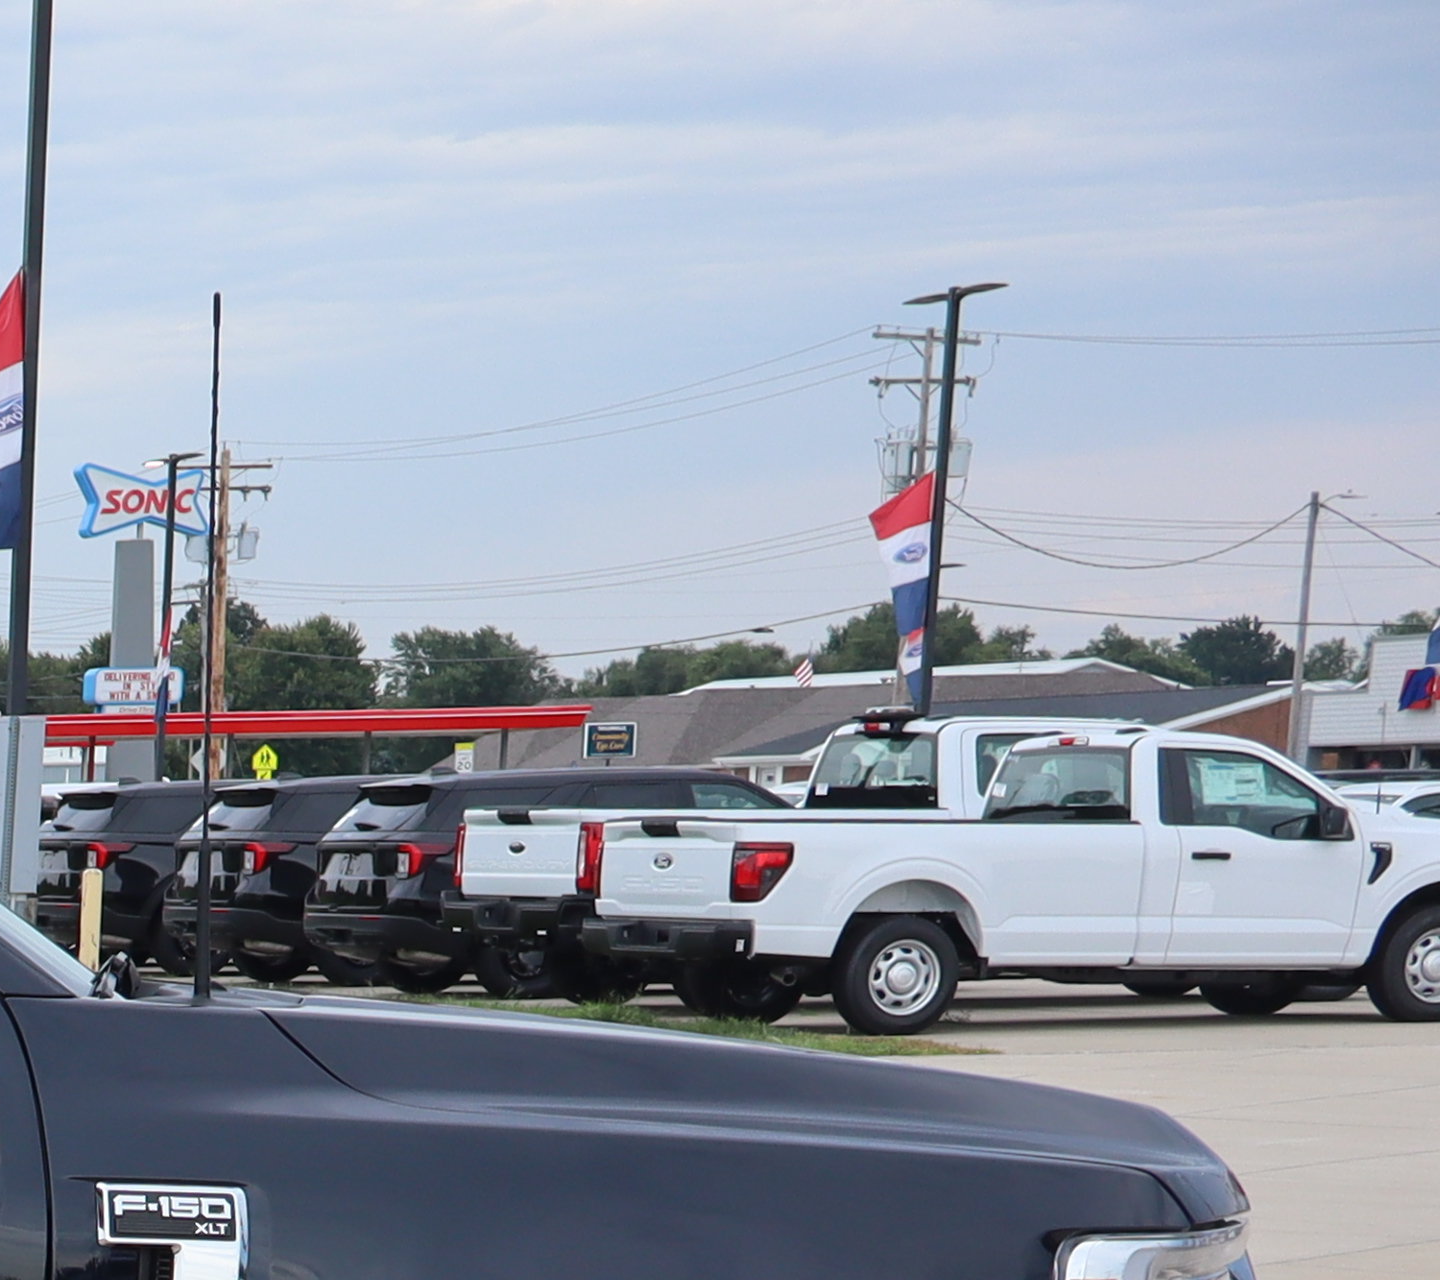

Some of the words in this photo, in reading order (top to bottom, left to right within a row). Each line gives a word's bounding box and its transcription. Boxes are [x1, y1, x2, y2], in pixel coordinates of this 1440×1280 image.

[101, 489, 195, 514] SONC
[104, 672, 151, 681] DELIVERING
[109, 692, 130, 700] WITH
[135, 692, 141, 700] A
[457, 761, 471, 770] 20
[113, 1195, 232, 1219] F-150
[194, 1222, 229, 1235] XLT
